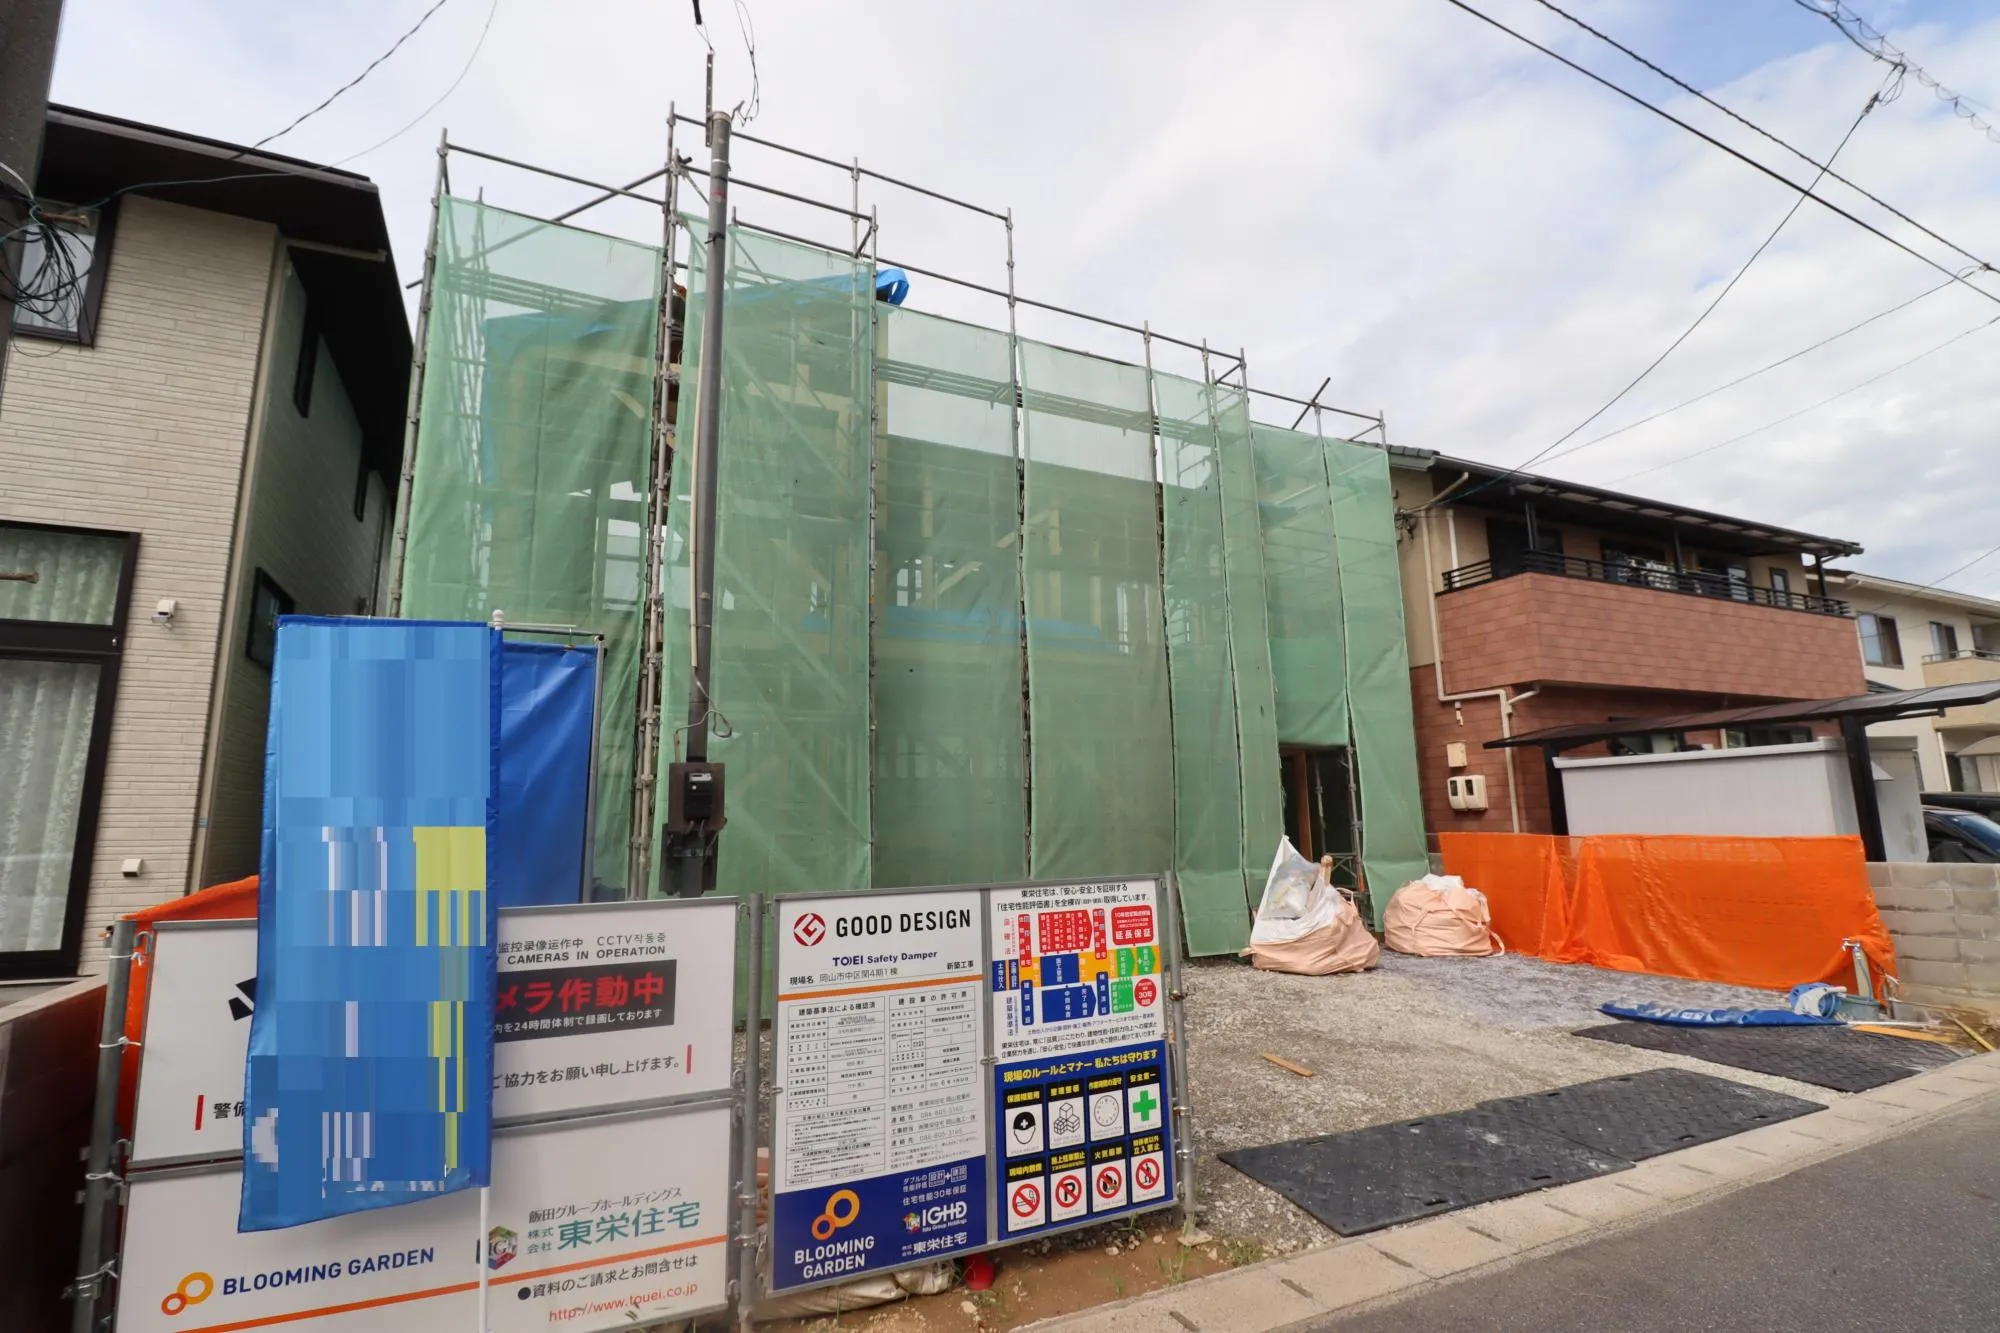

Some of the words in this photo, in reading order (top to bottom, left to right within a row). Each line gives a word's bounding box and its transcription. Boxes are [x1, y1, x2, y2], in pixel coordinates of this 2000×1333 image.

[836, 914, 892, 937] GOOD
[900, 909, 971, 932] DESIGN
[507, 952, 570, 965] CAMERAS
[576, 951, 589, 961] IN
[596, 946, 666, 959] OPERATION
[867, 954, 898, 965] Safety
[901, 951, 938, 962] Damper
[946, 960, 974, 970] 新築工事
[789, 975, 814, 986] 現場名
[528, 1187, 683, 1224] 飯田グループホールディングス
[557, 1202, 700, 1250] 東栄住宅
[794, 1236, 875, 1265] BLOOMING
[913, 1232, 967, 1255] 東栄住宅
[223, 1263, 342, 1295] BLOOMING
[348, 1247, 434, 1274] GARDEN
[803, 1254, 865, 1279] GARDEN
[549, 1282, 698, 1322] http://www.touei.co.jp
